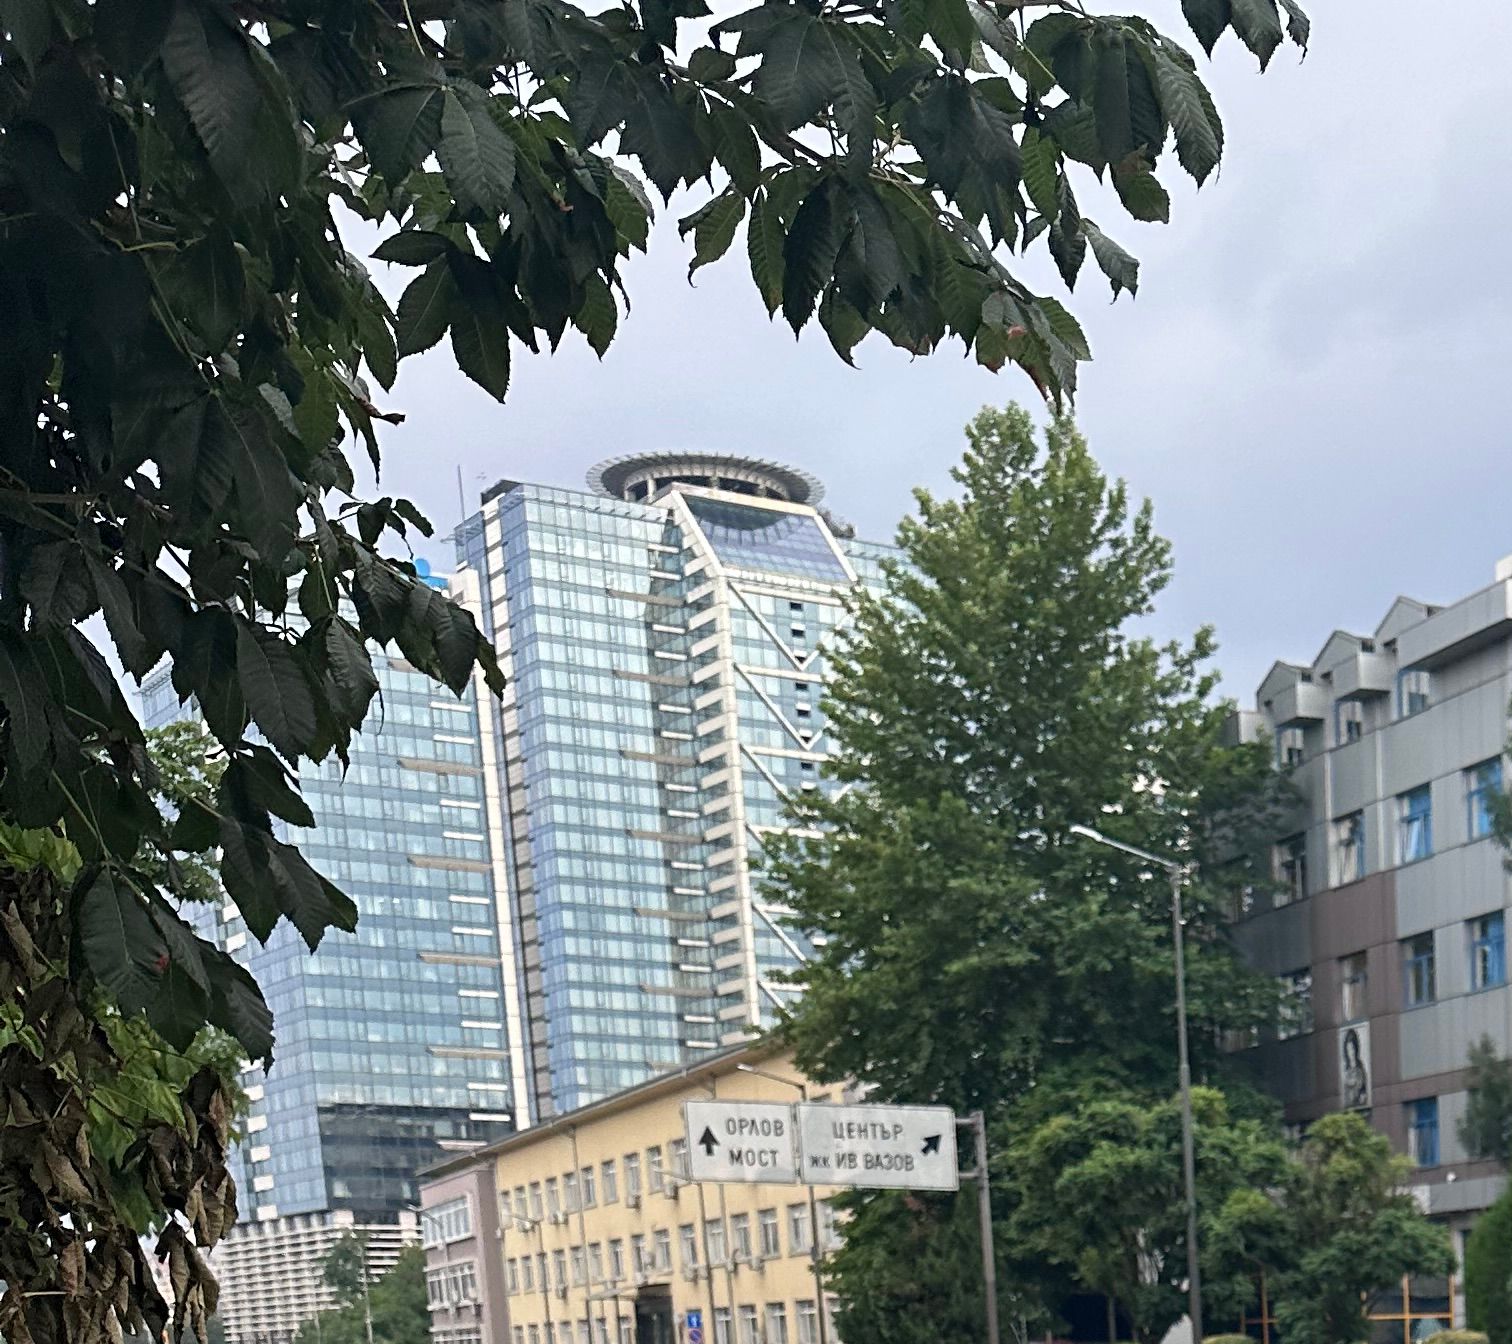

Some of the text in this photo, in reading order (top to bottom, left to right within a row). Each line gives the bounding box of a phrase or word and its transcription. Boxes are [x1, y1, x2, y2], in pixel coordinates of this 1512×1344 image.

[725, 1117, 785, 1137] ОРЛОВ
[831, 1121, 904, 1142] ЦЕНТЪР
[728, 1147, 779, 1168] МОСТ
[835, 1152, 858, 1170] ИВ
[863, 1152, 915, 1172] ВАЗОВ
